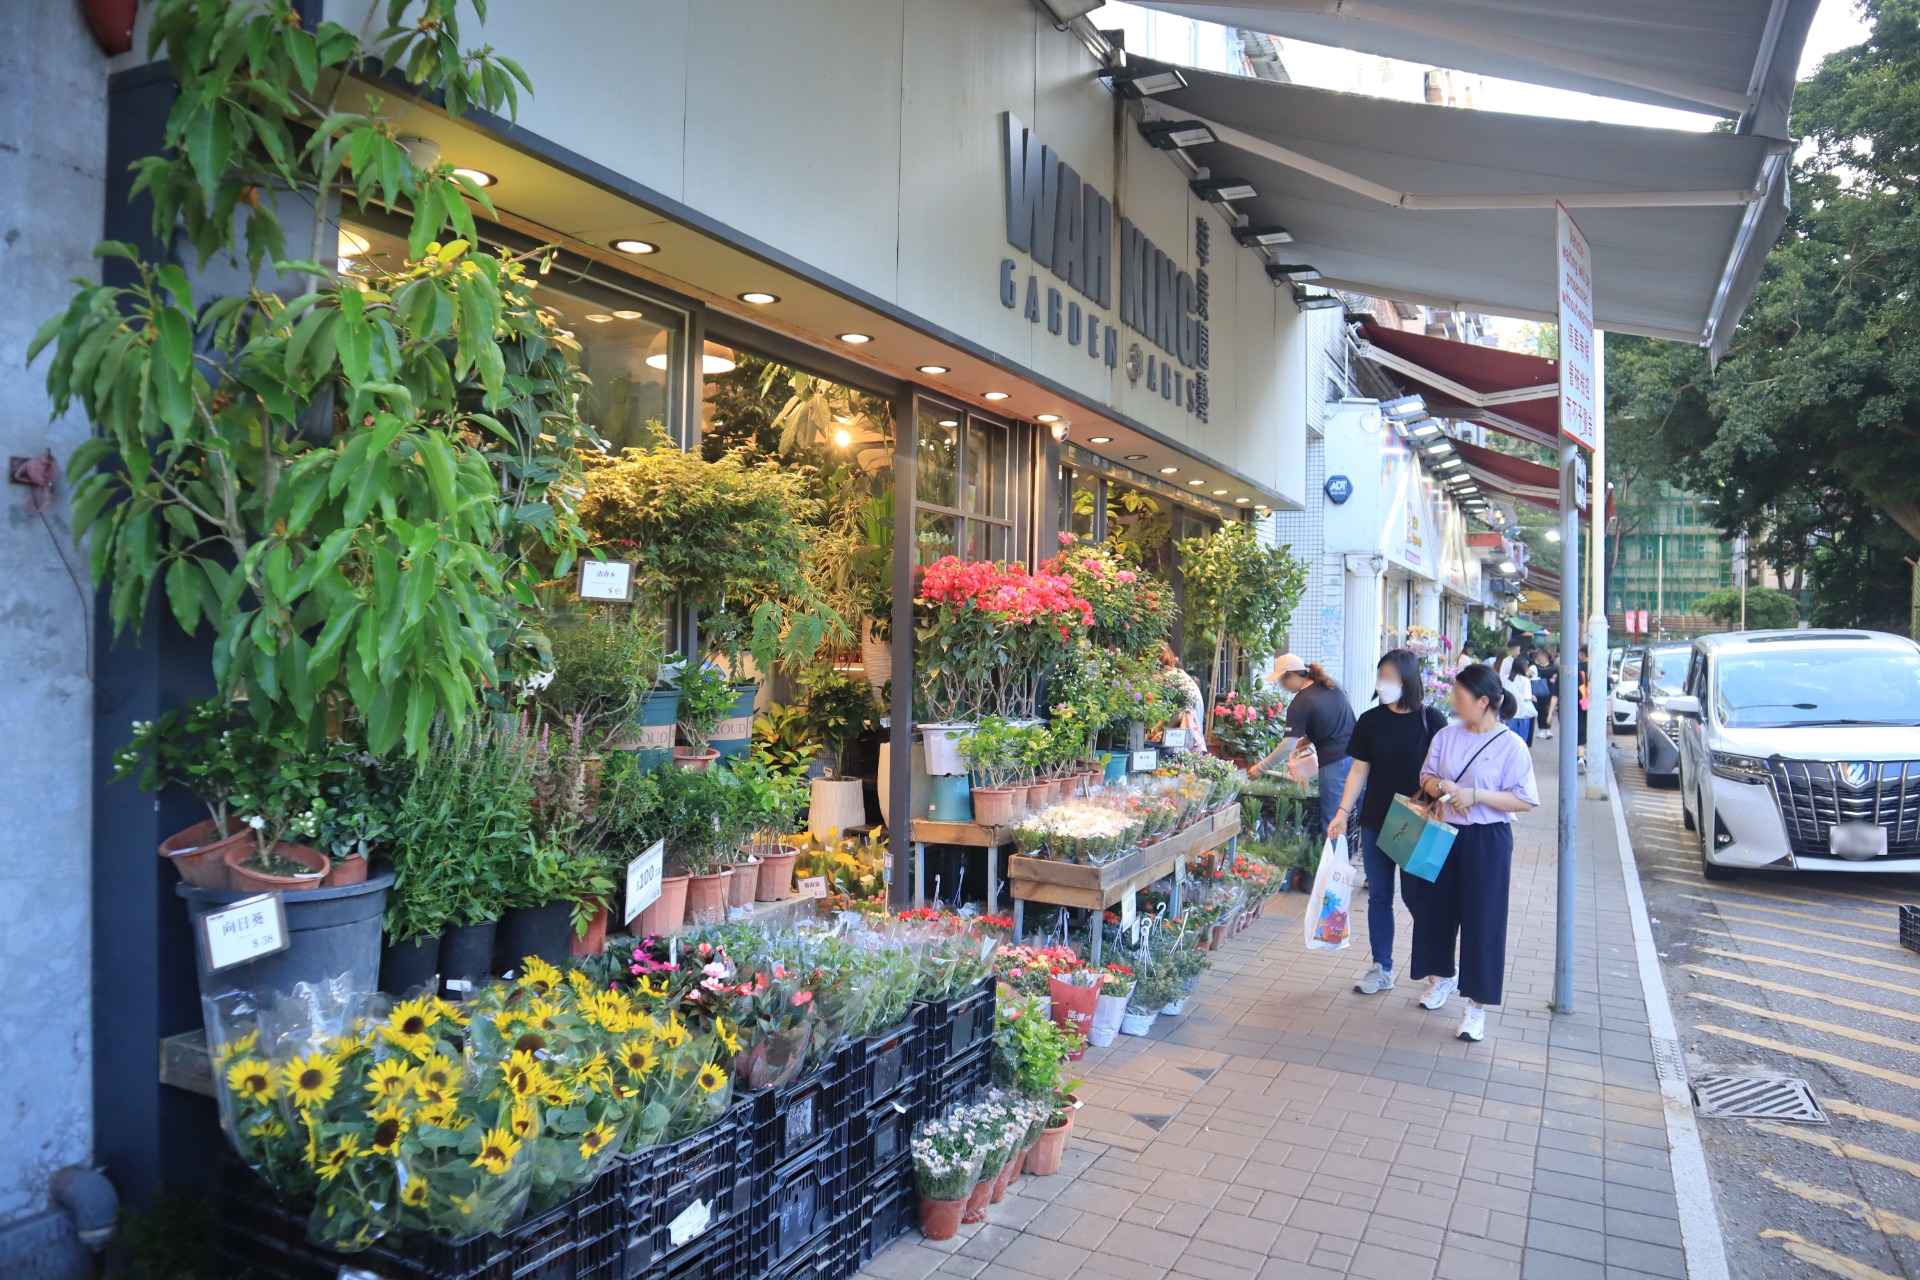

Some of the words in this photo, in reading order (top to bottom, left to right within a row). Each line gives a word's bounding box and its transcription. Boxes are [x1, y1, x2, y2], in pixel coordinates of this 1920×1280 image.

[1003, 111, 1112, 310] WAH
[1121, 216, 1196, 369] KING
[1000, 259, 1117, 369] GARDEN
[1147, 354, 1196, 412] ARTS
[1330, 481, 1347, 491] ADT
[222, 911, 265, 936] 向日葵
[251, 938, 259, 948] $
[262, 933, 274, 946] 38
